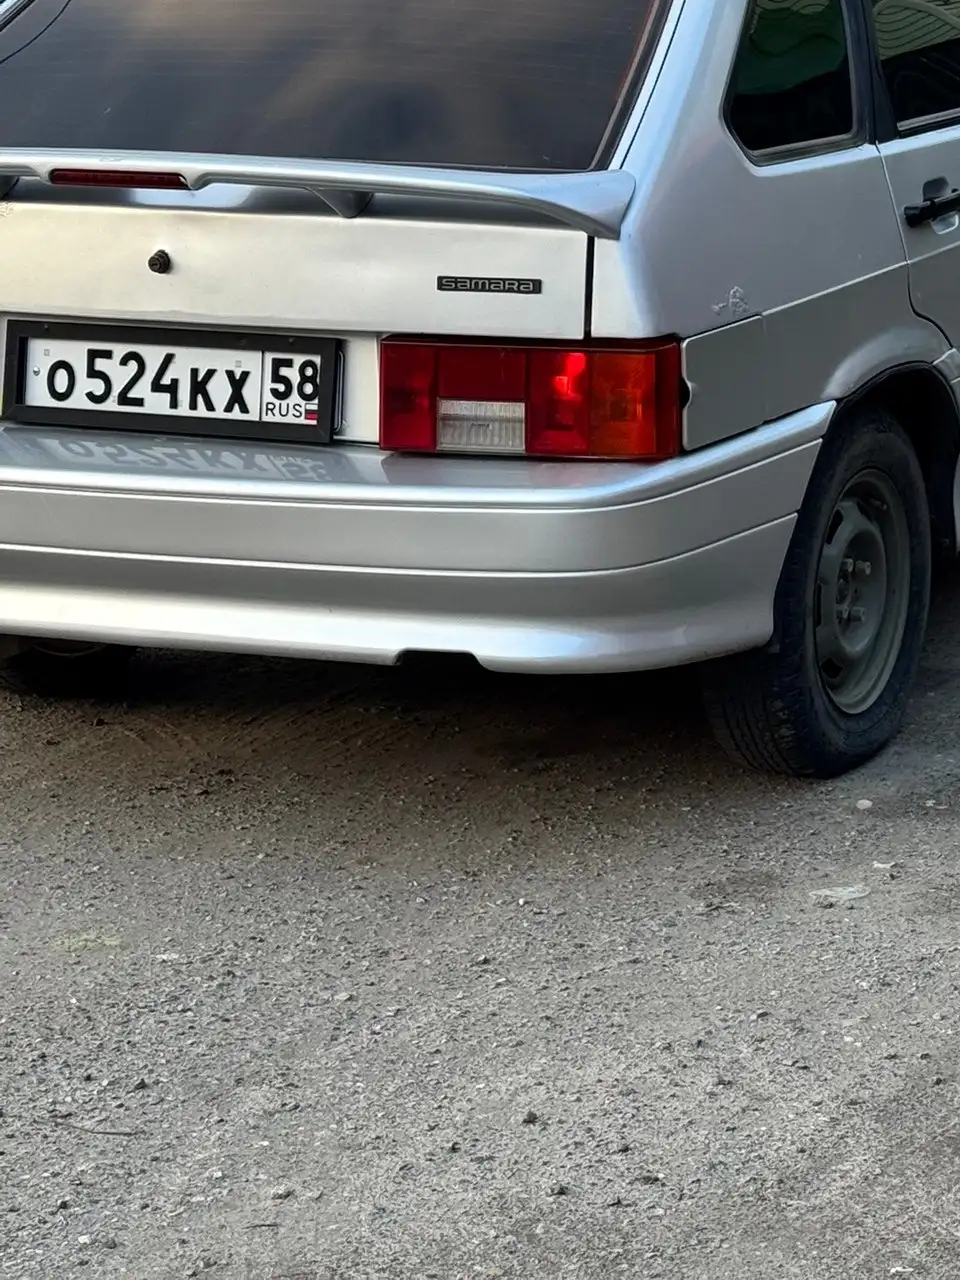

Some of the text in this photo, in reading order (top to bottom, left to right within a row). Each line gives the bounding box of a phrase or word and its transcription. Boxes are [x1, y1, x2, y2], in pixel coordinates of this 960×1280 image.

[46, 348, 319, 414] О524КХ 58
[264, 401, 303, 418] RUS
